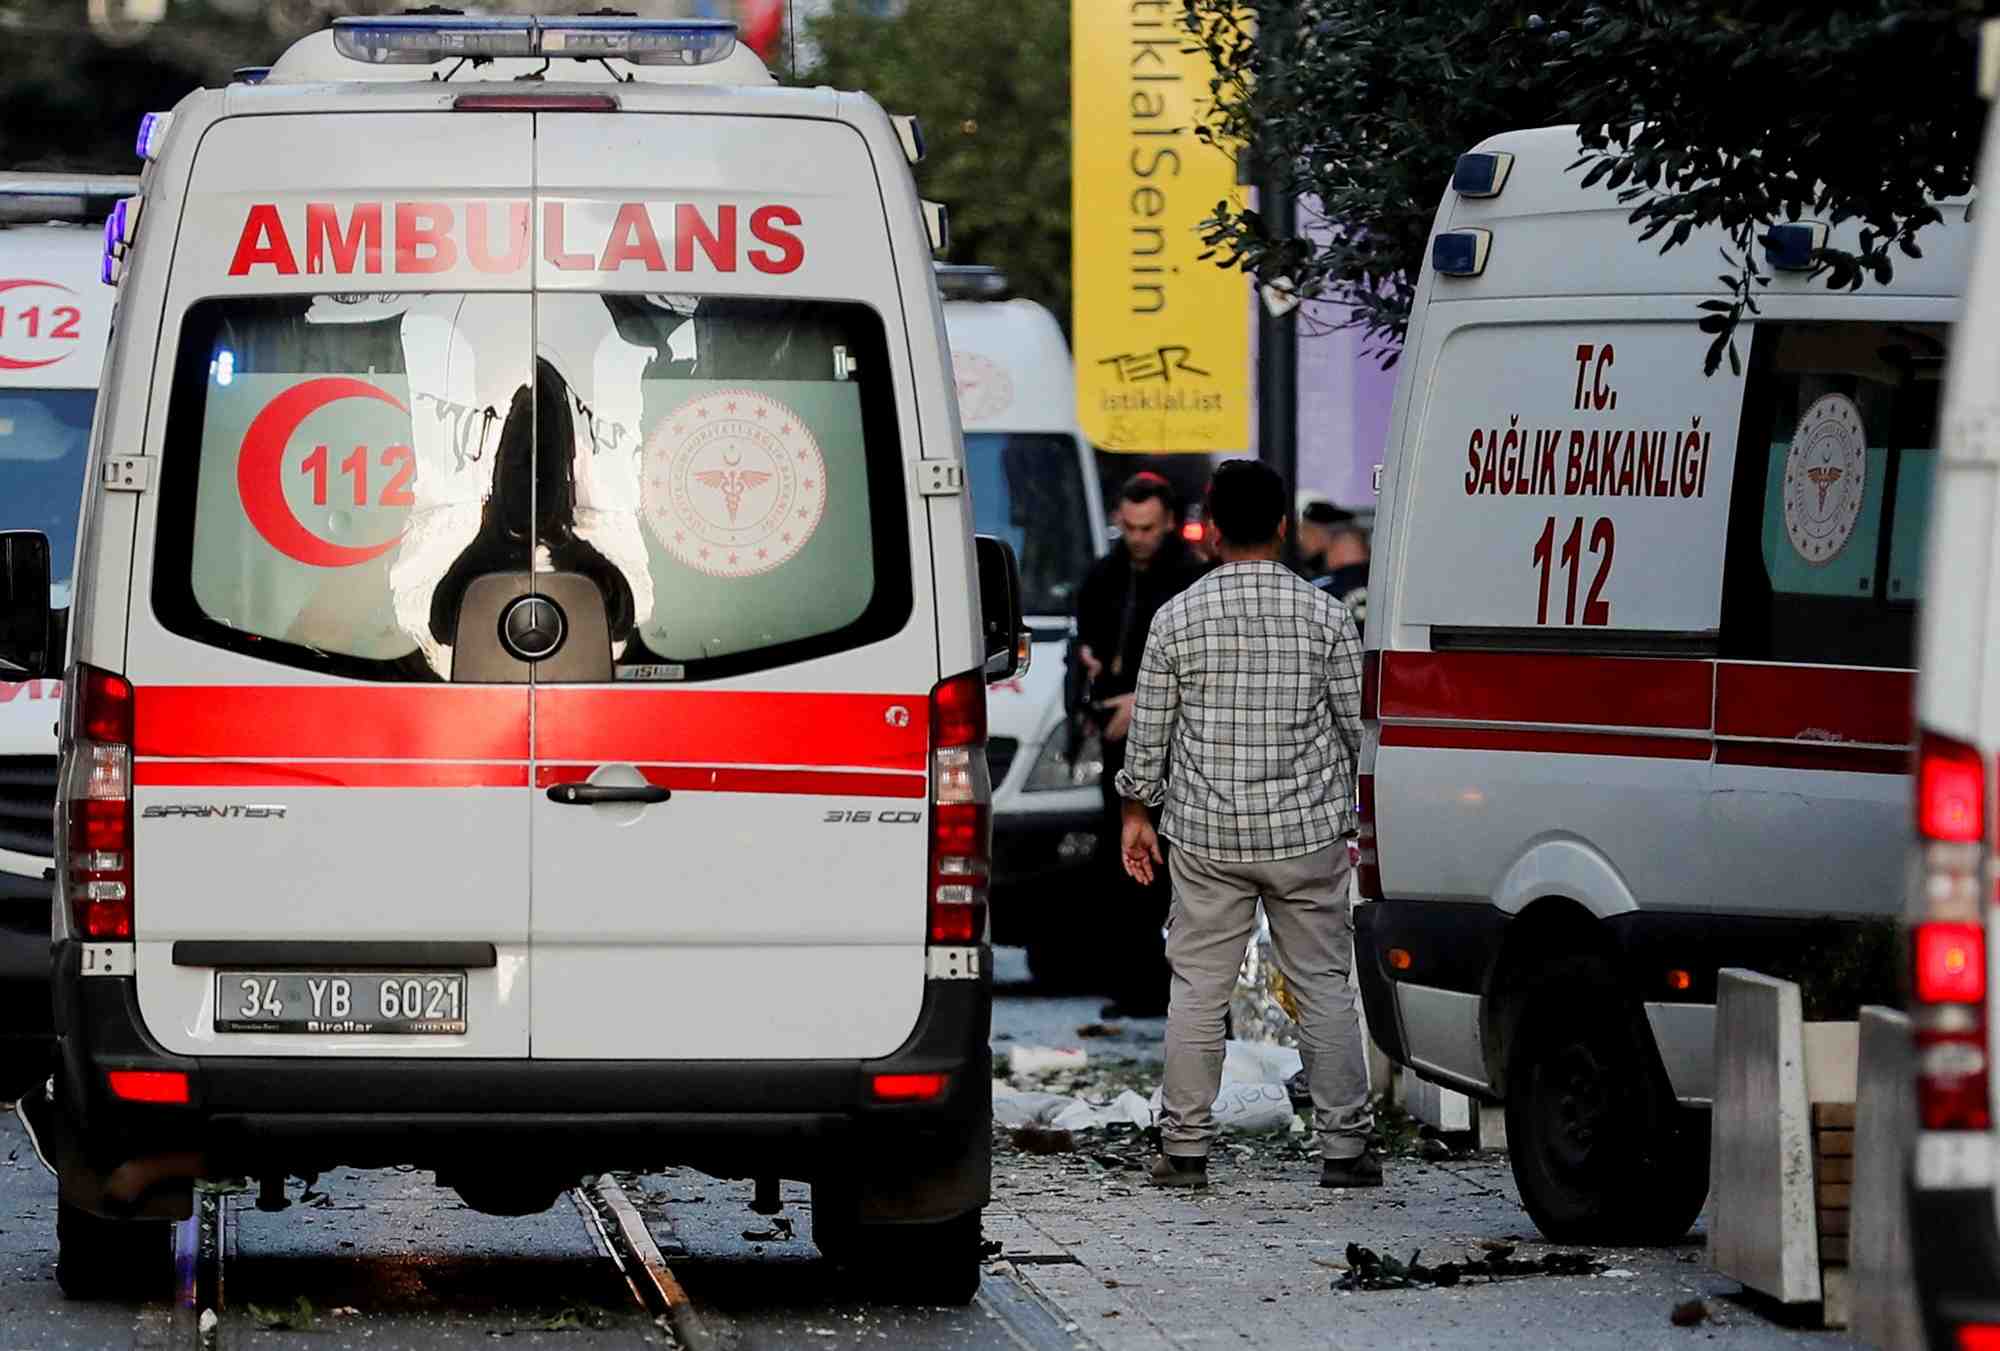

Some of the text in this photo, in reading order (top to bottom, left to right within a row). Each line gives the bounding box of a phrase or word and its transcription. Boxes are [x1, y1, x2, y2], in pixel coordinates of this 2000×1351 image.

[227, 202, 806, 276] AMBULANS
[0, 305, 80, 338] 12
[1574, 344, 1617, 410] T.C.
[302, 445, 416, 506] 112
[1465, 414, 1562, 496] SAĞLIK
[1564, 415, 1711, 498] BAKANLIĞI
[1533, 516, 1615, 625] 112
[142, 804, 287, 818] SPRINTER
[823, 810, 872, 823] 316
[240, 979, 461, 1018] 34 YB 6021
